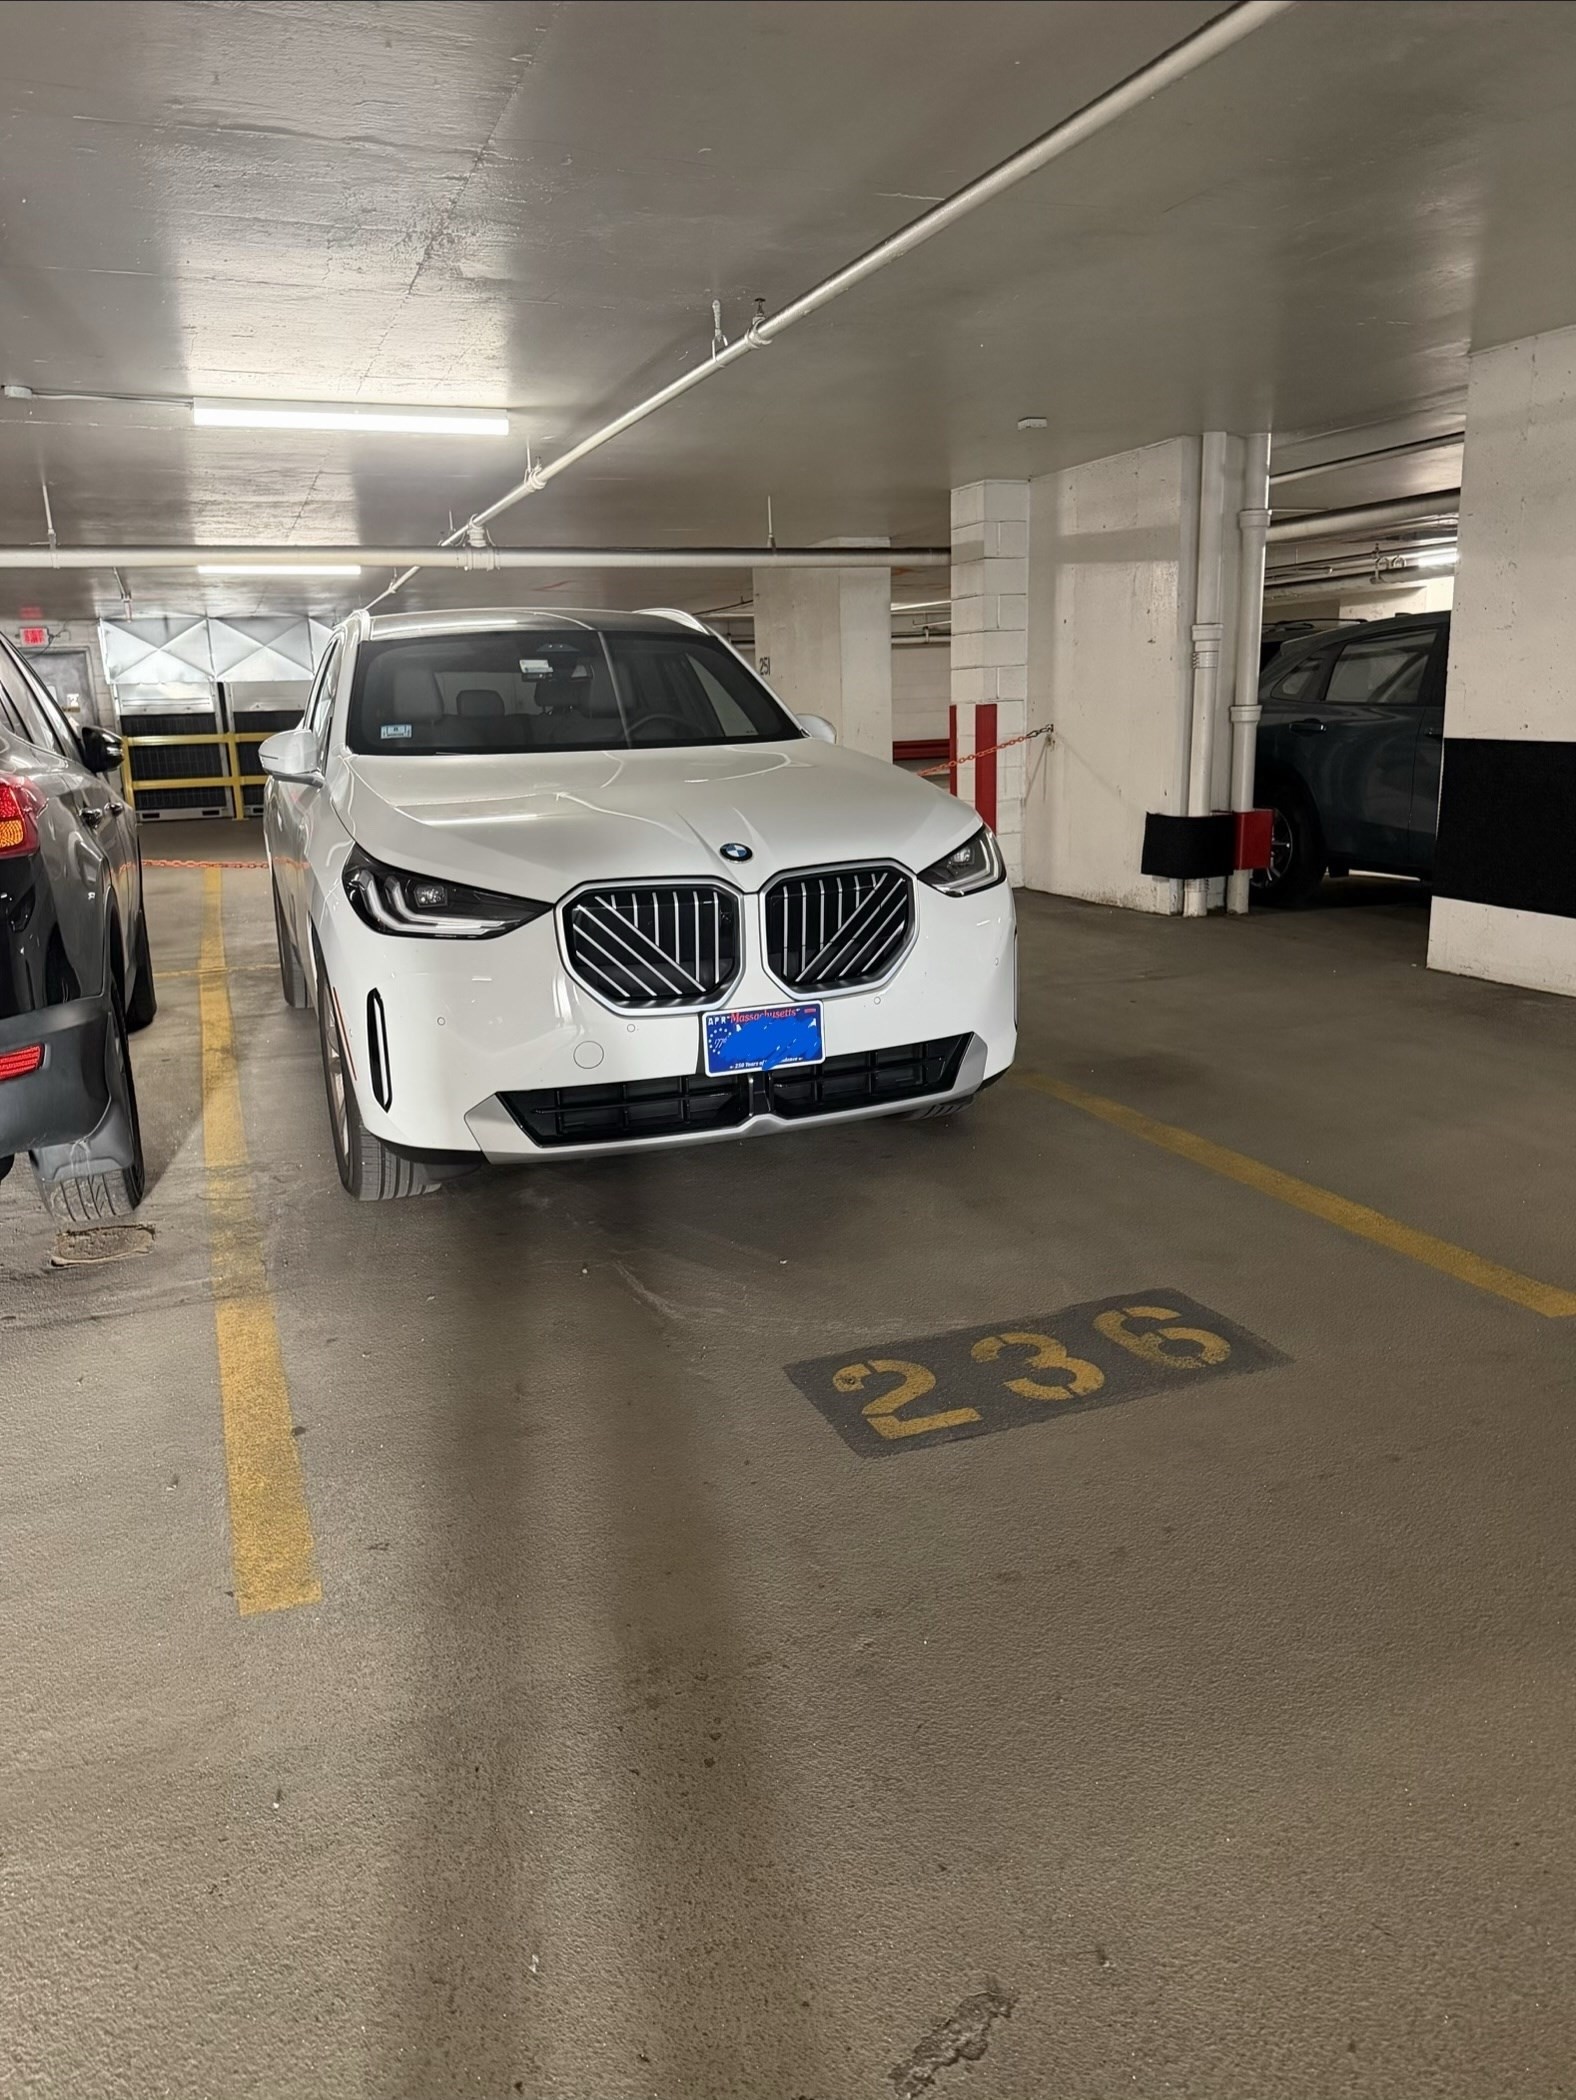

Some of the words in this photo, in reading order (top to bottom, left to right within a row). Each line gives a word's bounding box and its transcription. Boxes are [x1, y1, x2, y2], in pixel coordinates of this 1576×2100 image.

[760, 656, 770, 676] 251
[708, 1016, 726, 1026] APR
[832, 1306, 1231, 1439] 236
